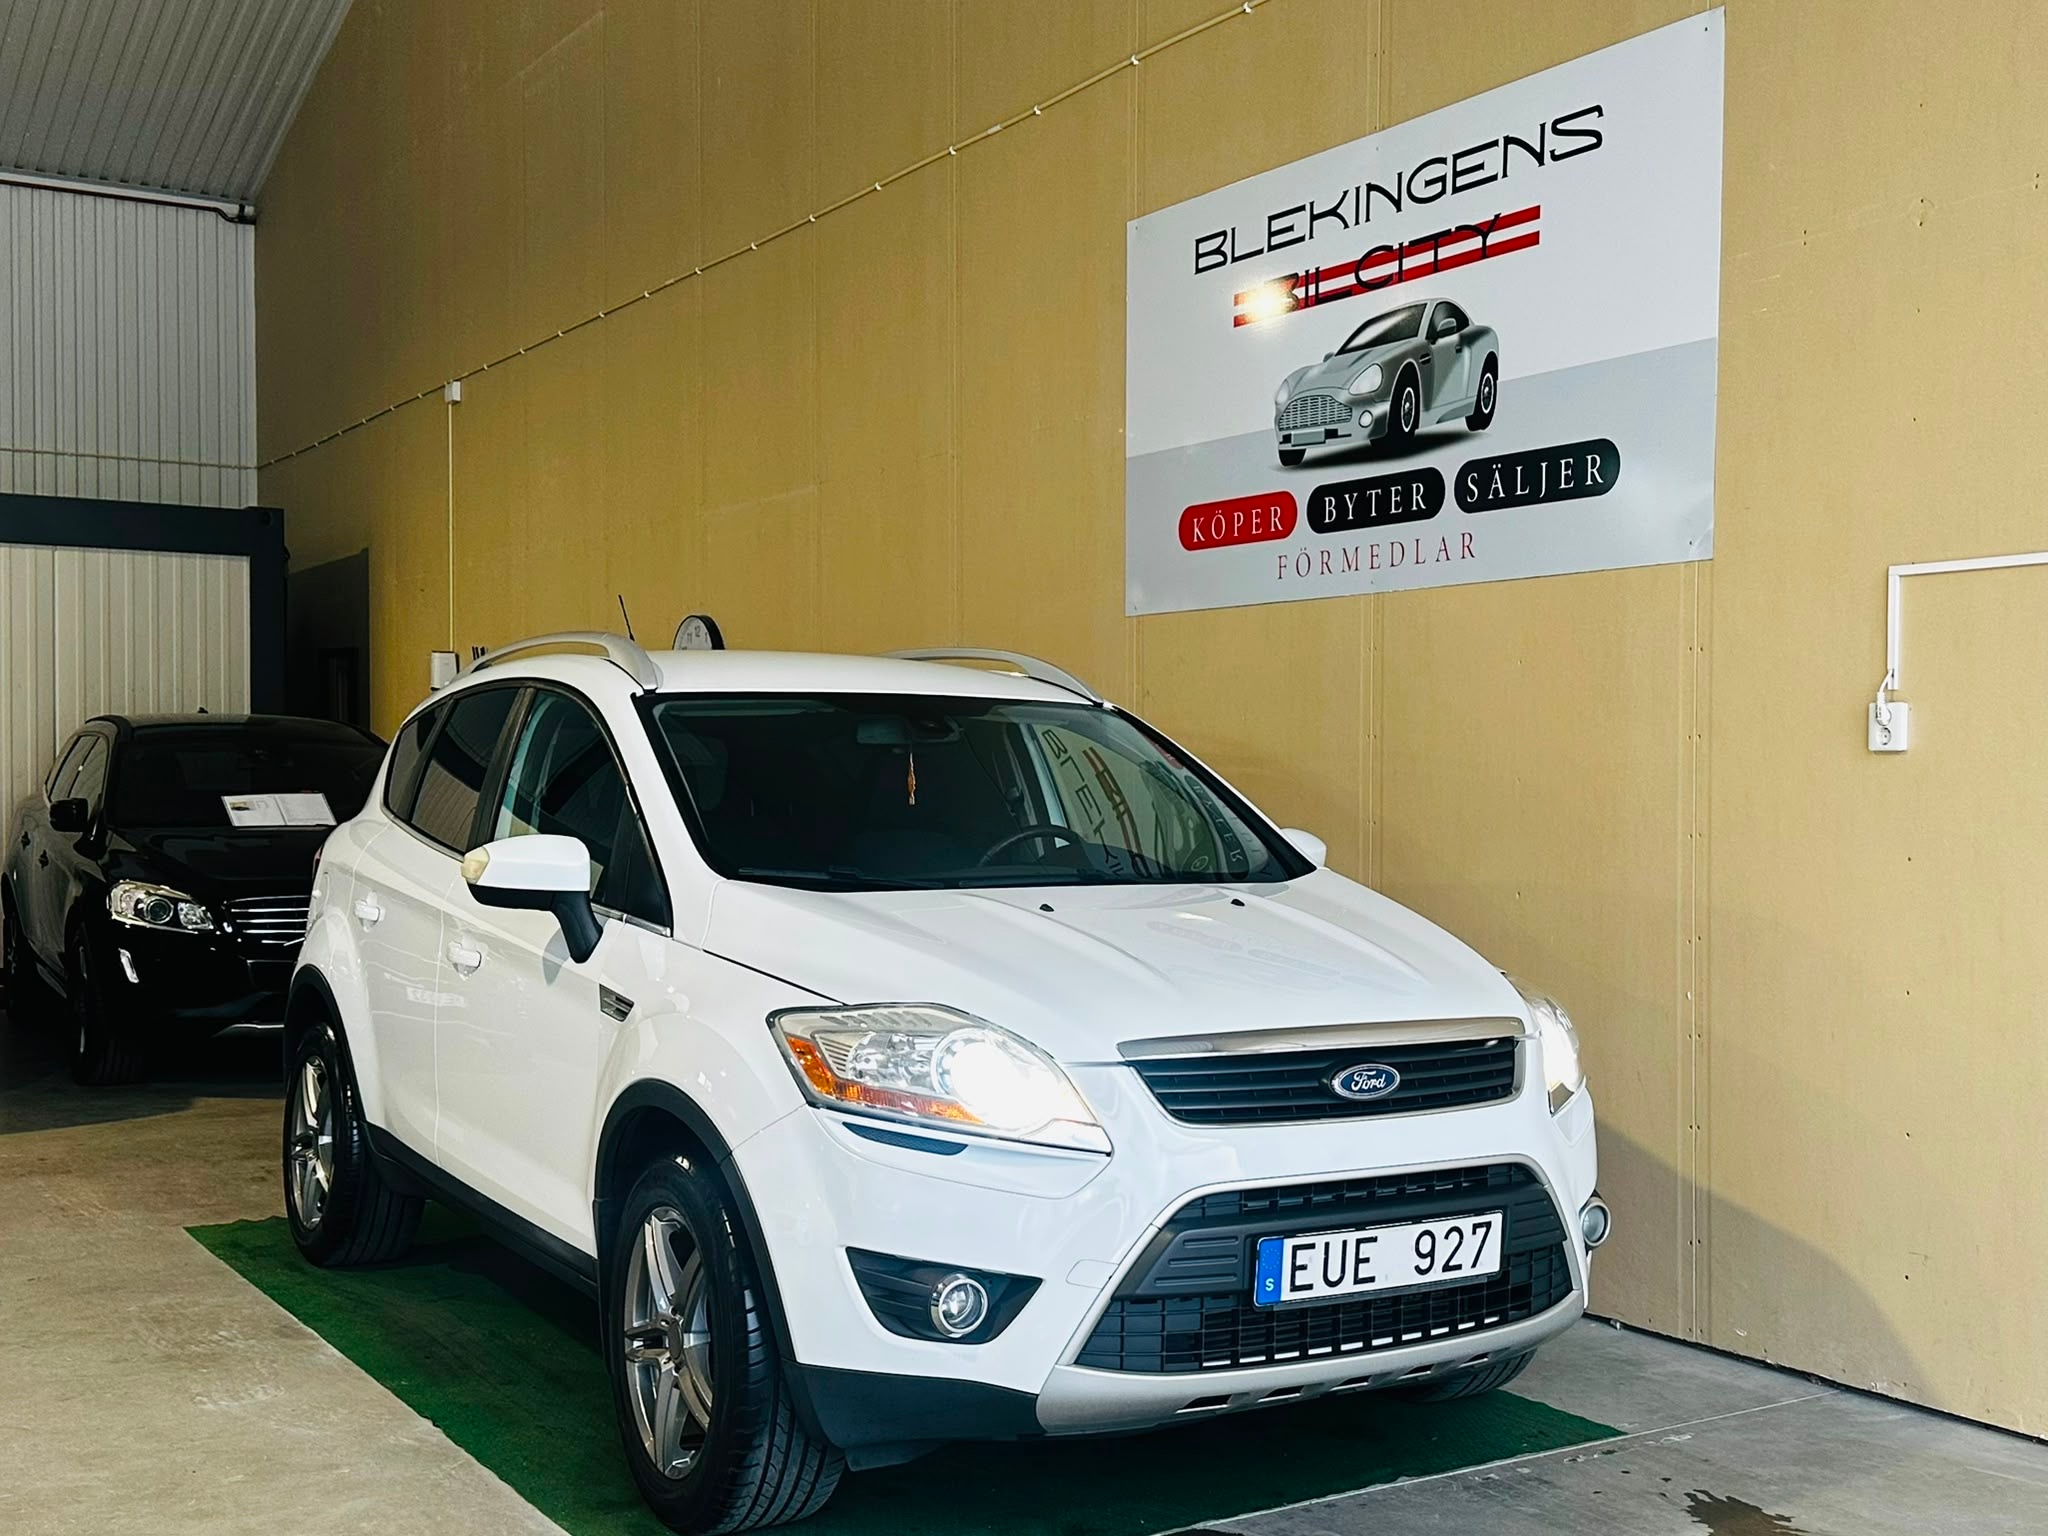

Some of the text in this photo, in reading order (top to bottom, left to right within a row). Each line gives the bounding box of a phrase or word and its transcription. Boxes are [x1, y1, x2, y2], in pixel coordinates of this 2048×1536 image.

[1194, 104, 1604, 275] BLEKINGENS
[1193, 454, 1605, 543] KÖPER BYTER SÄLJER
[1277, 531, 1477, 581] FÖRMEDLAR
[1351, 1071, 1386, 1091] Ford
[1265, 1277, 1275, 1292] S
[1289, 1220, 1493, 1292] EUE 927
